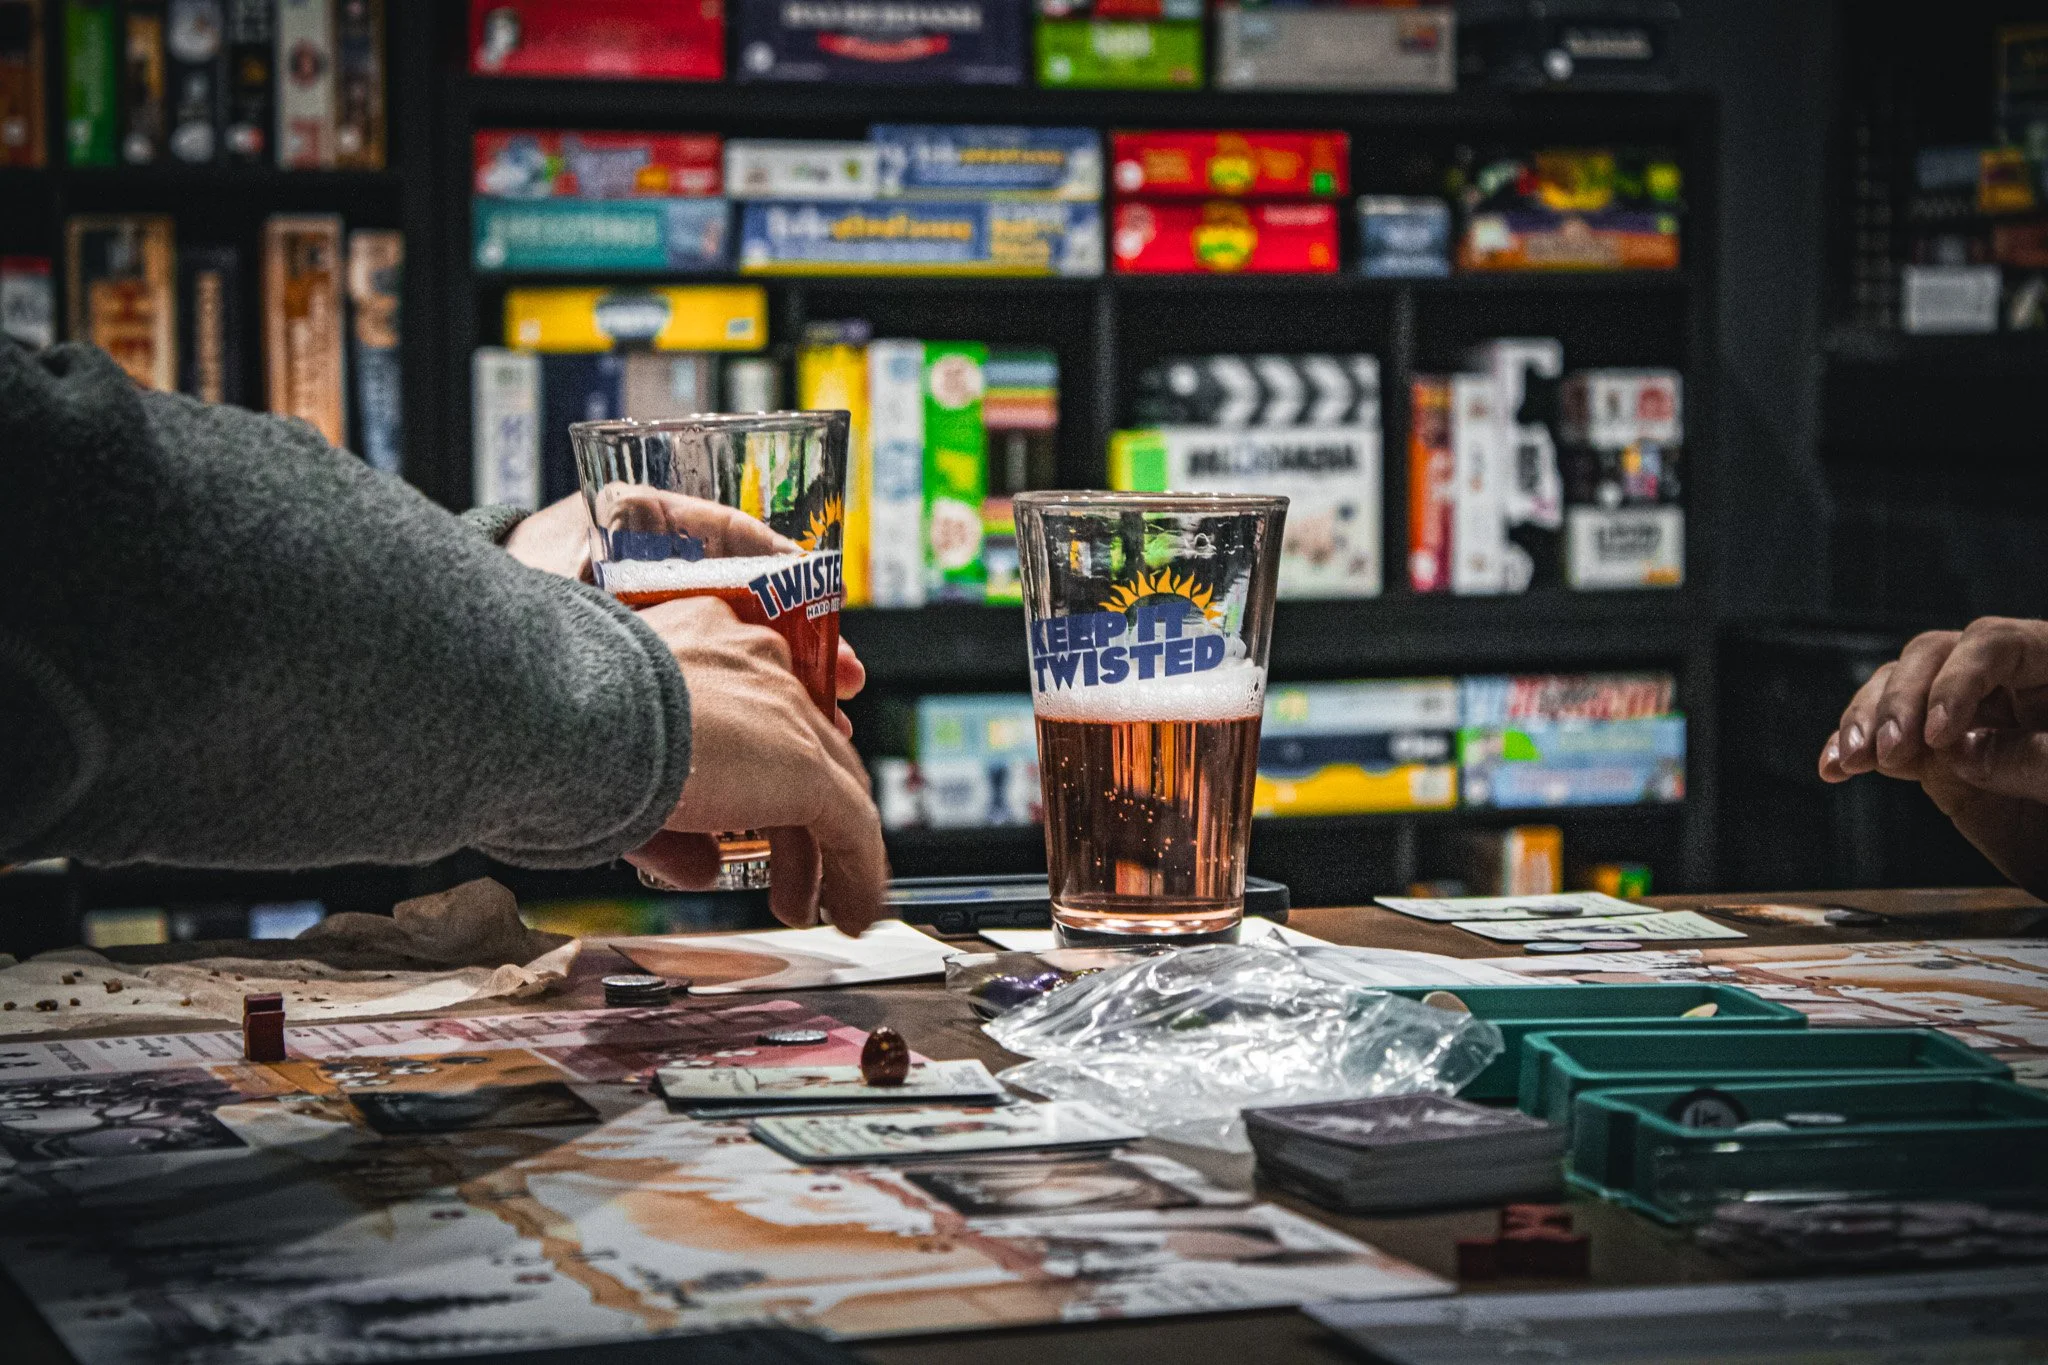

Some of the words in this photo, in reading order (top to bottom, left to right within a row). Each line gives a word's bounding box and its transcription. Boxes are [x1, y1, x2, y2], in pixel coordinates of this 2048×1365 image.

[748, 554, 841, 619] TWISTE
[806, 599, 830, 619] HARD
[1031, 611, 1127, 656] KEEP
[1138, 602, 1191, 643] IT
[1033, 633, 1226, 692] TWISTED
